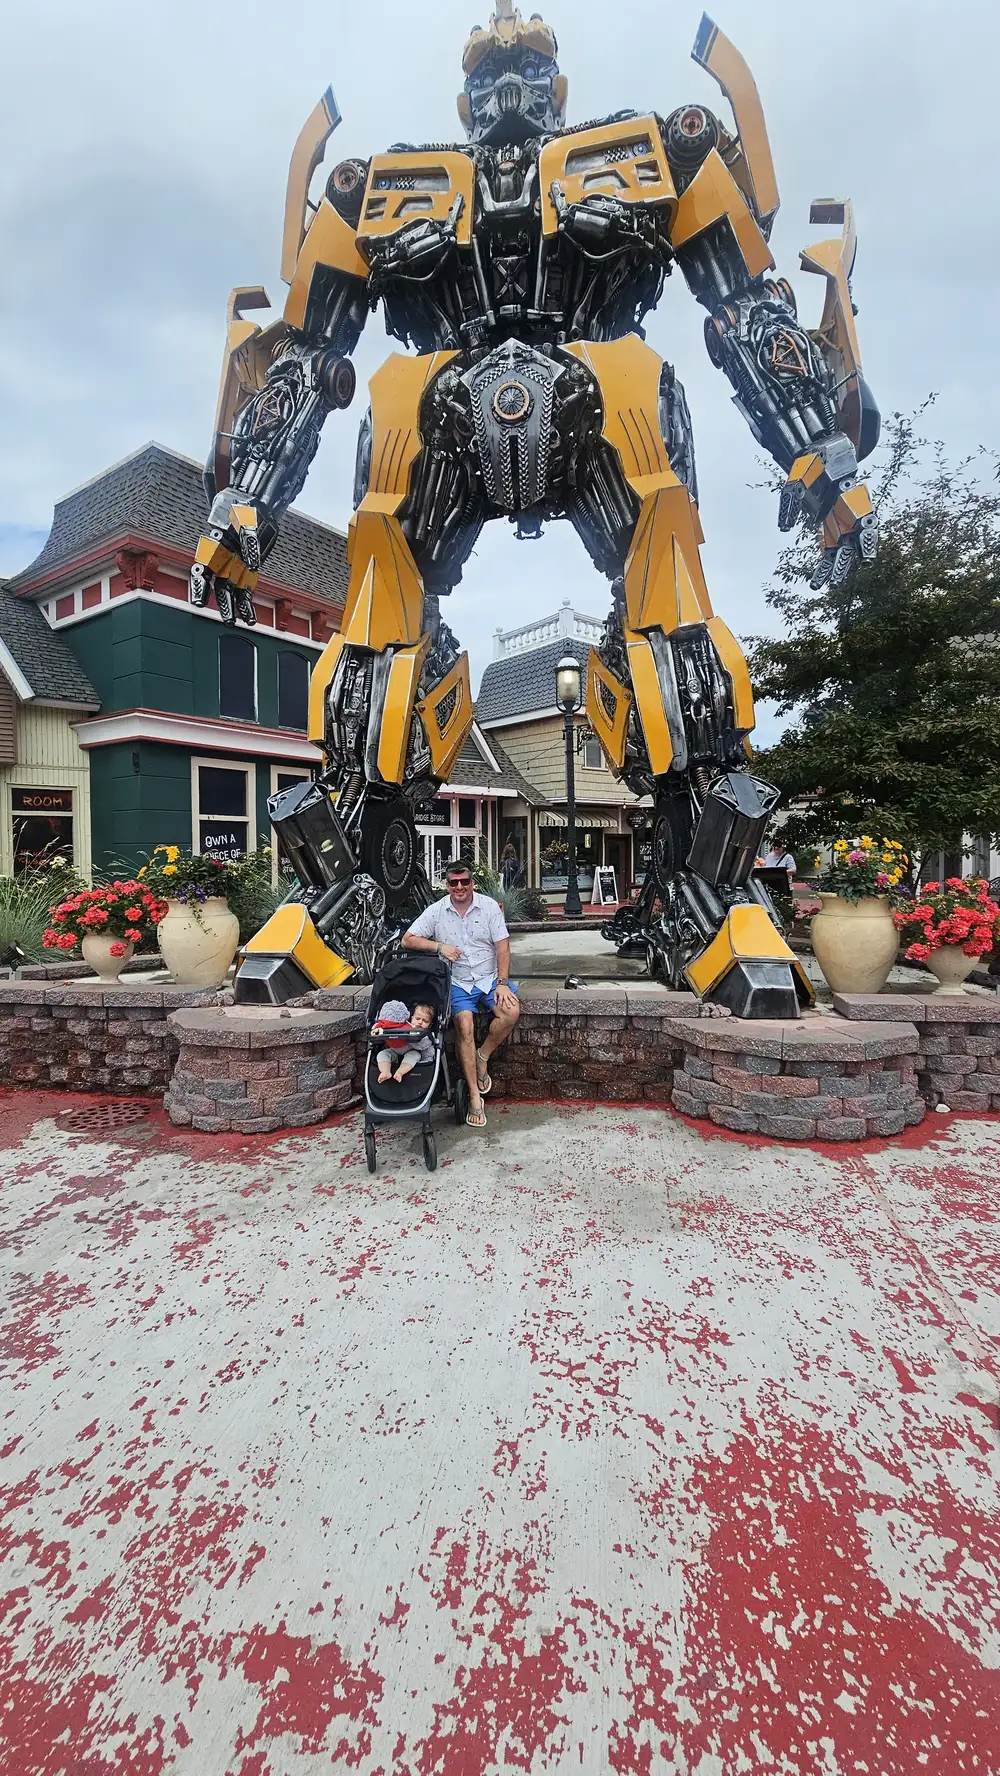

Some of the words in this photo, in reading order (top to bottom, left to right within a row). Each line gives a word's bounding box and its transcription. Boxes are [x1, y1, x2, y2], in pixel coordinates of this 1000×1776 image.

[23, 796, 62, 807] ROOM
[414, 814, 429, 822] RIDGE
[430, 814, 445, 823] STORE
[205, 834, 228, 847] OWN
[230, 833, 236, 843] A
[231, 848, 241, 858] OF
